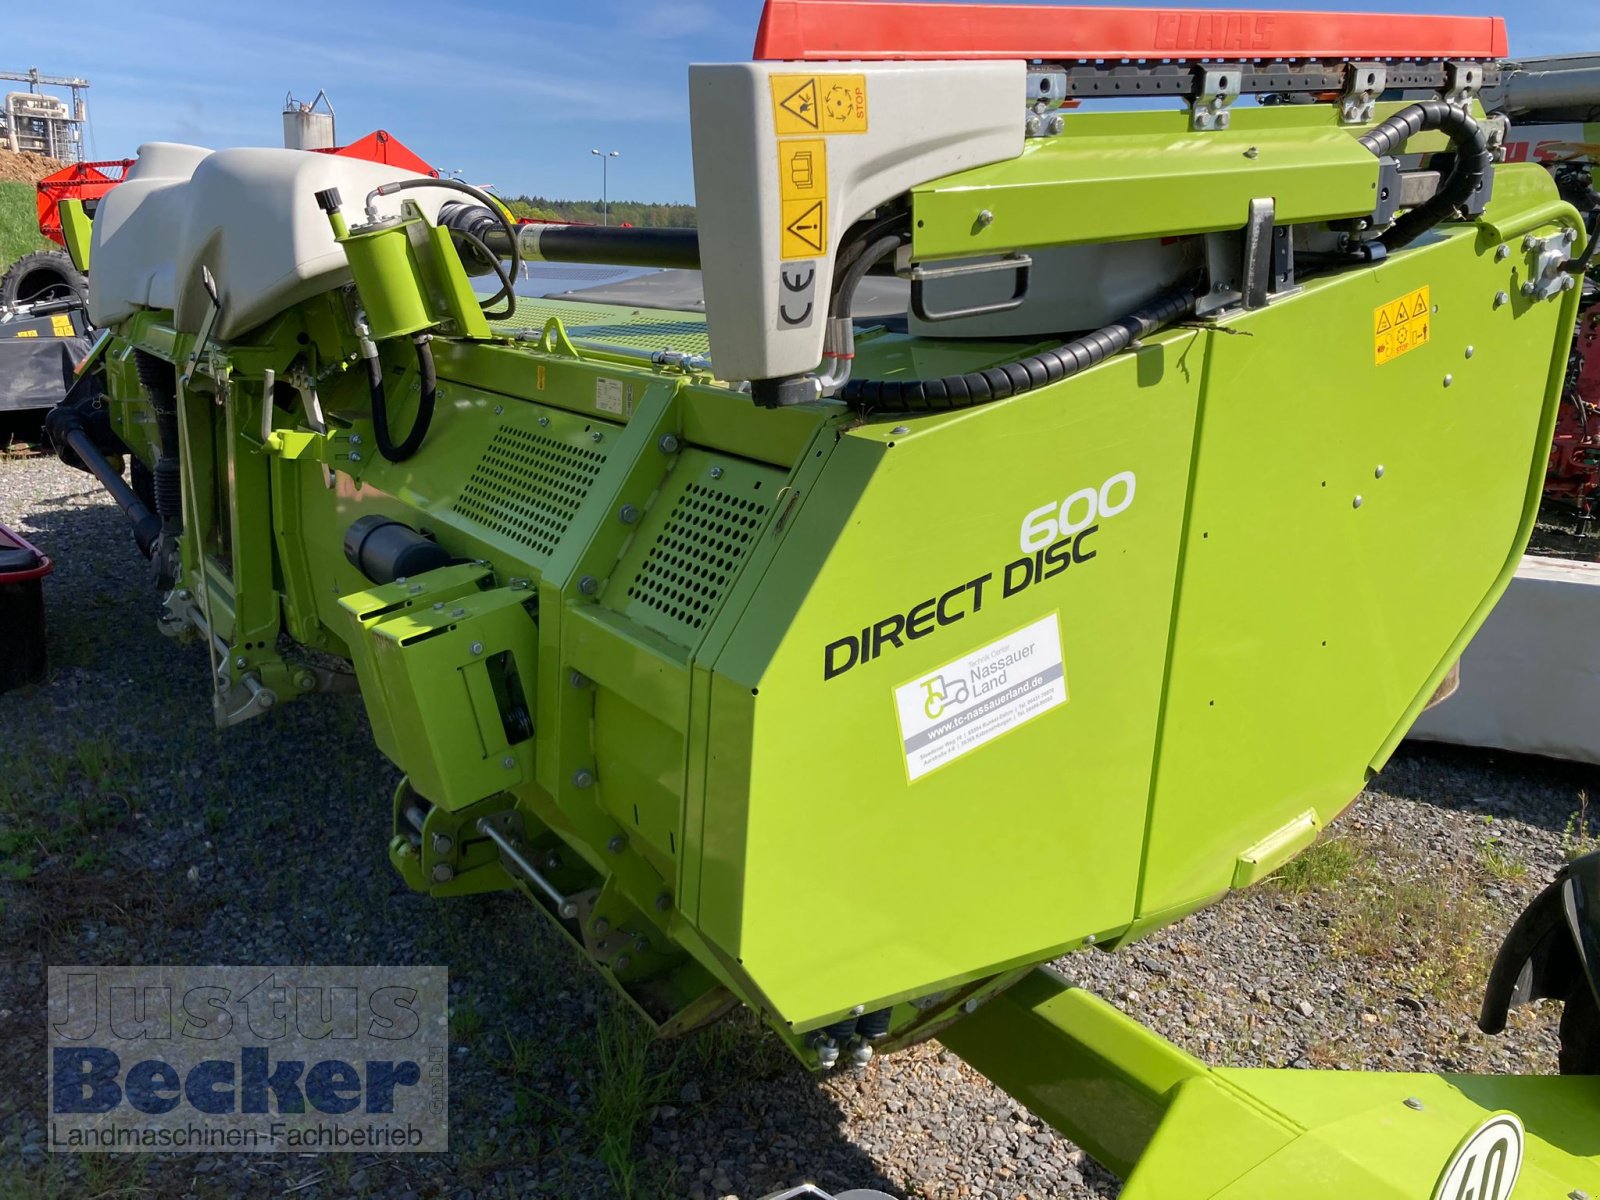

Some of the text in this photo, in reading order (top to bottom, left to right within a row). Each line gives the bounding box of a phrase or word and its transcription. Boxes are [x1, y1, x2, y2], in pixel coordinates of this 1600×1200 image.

[1154, 13, 1276, 50] CLAAS
[856, 88, 865, 119] STOP
[1020, 470, 1136, 554] 600
[824, 524, 1099, 682] DIRECT DISC
[970, 643, 1035, 683] Nassauer
[973, 670, 1007, 698] Land
[927, 675, 1044, 740] www.tc-nassauerland.de
